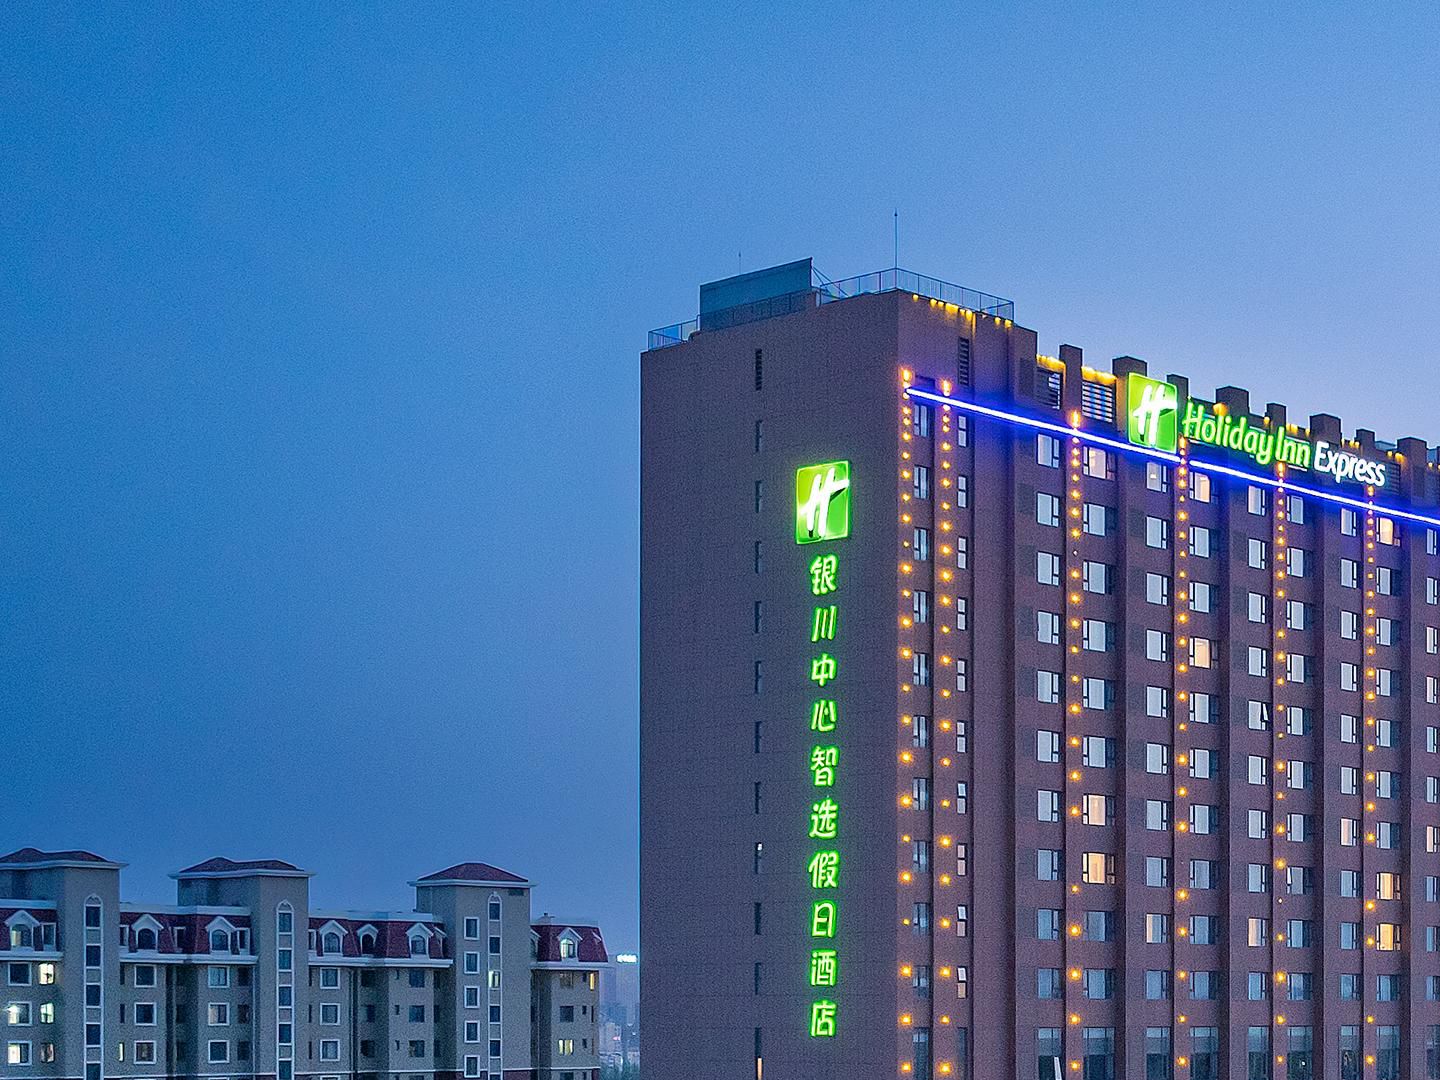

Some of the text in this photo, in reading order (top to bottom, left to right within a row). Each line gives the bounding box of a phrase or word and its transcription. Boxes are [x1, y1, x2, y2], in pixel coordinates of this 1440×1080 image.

[1182, 401, 1386, 487] Holiday Inn Express
[809, 555, 838, 1038] 银川中心智选假日酒店
